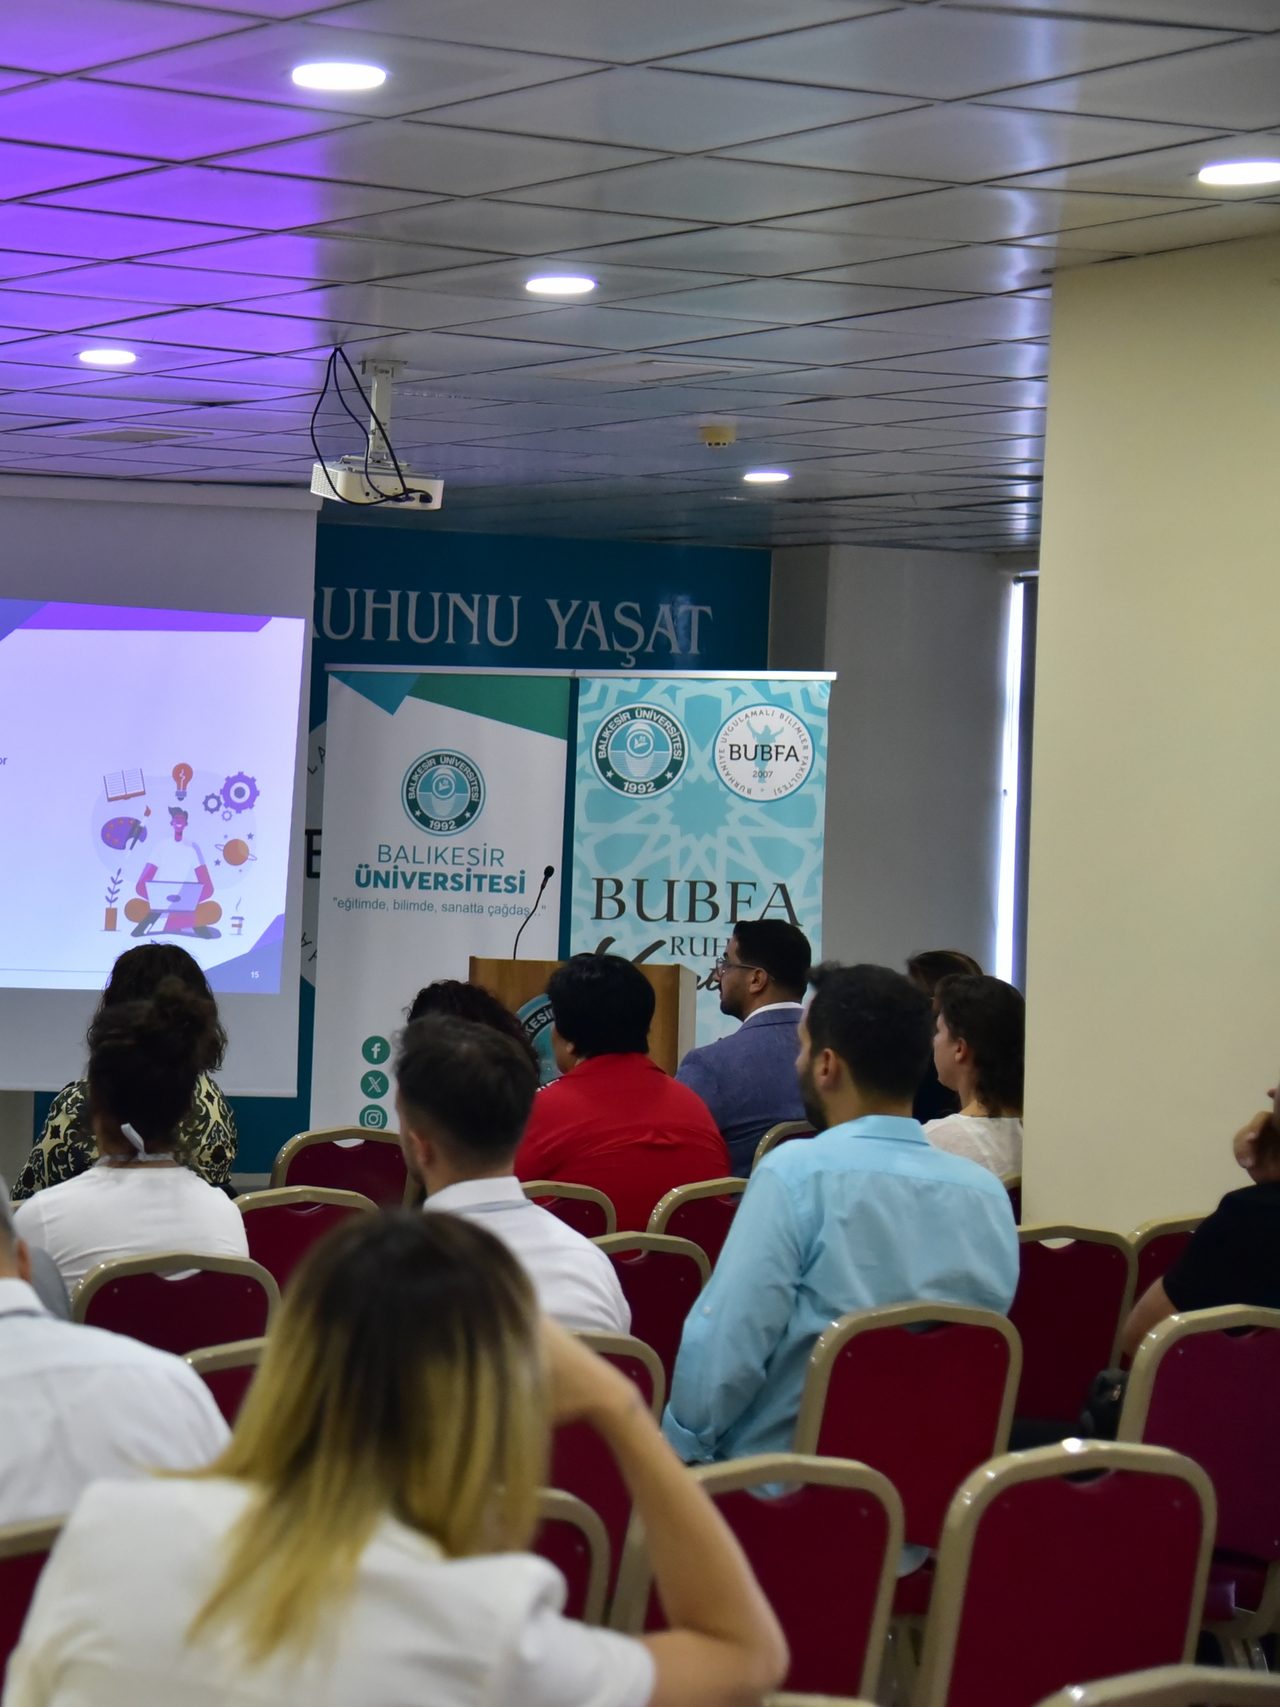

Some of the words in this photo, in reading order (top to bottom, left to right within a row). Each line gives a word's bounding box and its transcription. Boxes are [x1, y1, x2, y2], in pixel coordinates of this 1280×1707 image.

[313, 587, 522, 647] UHUNU
[545, 599, 713, 668] YAŞAT
[729, 743, 800, 762] BUBFA
[752, 770, 774, 779] 2007
[623, 782, 656, 793] 1992
[429, 820, 457, 831] 1992
[377, 843, 505, 867] BALIKESİR
[355, 863, 526, 894] ÜNİVERSİTESİ
[393, 899, 437, 913] bilimde,
[441, 903, 484, 914] sanatta
[590, 877, 803, 927] BUBFA
[250, 970, 260, 979] 15
